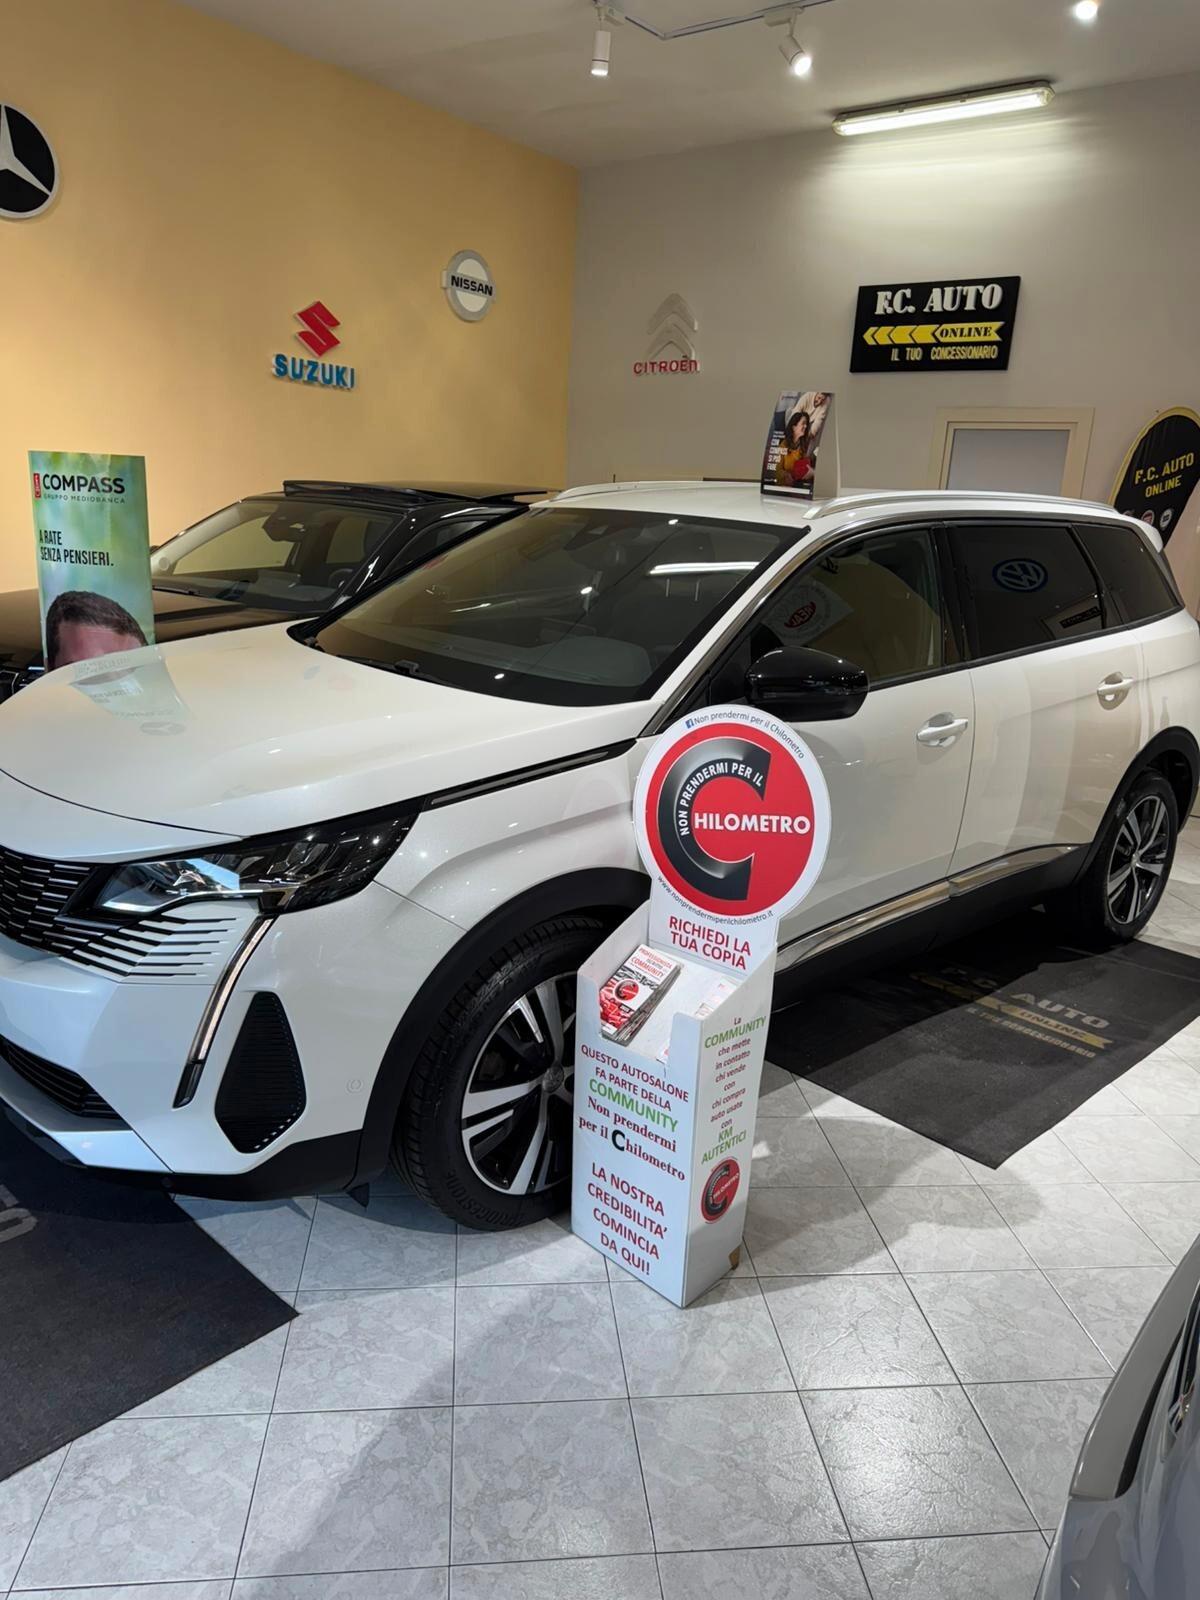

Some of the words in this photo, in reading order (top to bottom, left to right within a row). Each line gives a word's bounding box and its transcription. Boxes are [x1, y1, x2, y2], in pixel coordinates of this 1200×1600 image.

[451, 275, 493, 296] NISSAN
[874, 287, 916, 315] F.C.
[923, 283, 1003, 313] AUTO
[940, 326, 992, 339] ONLINE
[891, 348, 900, 361] IL
[906, 347, 923, 361] TUO
[931, 345, 998, 361] CONCESSIONARIO
[272, 353, 356, 389] SUZUKI
[1134, 467, 1159, 485] F.C.
[1162, 452, 1195, 476] AUTO
[42, 473, 125, 494] COMPASS
[1145, 475, 1182, 498] ONLINE
[43, 493, 69, 501] GRUPPO
[71, 495, 125, 504] MEDIOBANCA
[39, 529, 44, 544] A
[44, 530, 62, 546] RATE
[40, 546, 62, 562] SENZA
[63, 549, 114, 567] PENSIERI.
[694, 714, 709, 725] Non
[711, 711, 749, 721] prendermi
[750, 716, 763, 726] per
[764, 721, 770, 729] il
[769, 723, 805, 759] Chilometro
[731, 762, 753, 779] PER
[752, 772, 764, 788] IL
[680, 762, 728, 808] PRENDERMI
[678, 810, 690, 836] NON
[669, 915, 729, 948] RICHIEDI
[733, 938, 751, 956] LA
[670, 930, 698, 952] TUA
[702, 944, 746, 970] COPIA
[631, 956, 664, 979] COMMUNITY
[733, 1017, 741, 1026] La
[1010, 993, 1110, 1028] AUTO
[704, 1016, 766, 1048] COMMUNITY
[1020, 1011, 1084, 1038] ONLINE
[715, 1061, 722, 1070] in
[723, 1050, 751, 1066] contatto
[718, 1045, 730, 1056] che
[731, 1038, 751, 1051] mette
[581, 1044, 619, 1069] QUESTO
[621, 1063, 688, 1103] AUTOSALONE
[715, 1072, 726, 1083] chi
[727, 1063, 746, 1077] vende
[723, 1081, 736, 1091] con
[595, 1067, 607, 1080] FA
[609, 1073, 638, 1095] PARTE
[641, 1088, 671, 1112] DELLA
[712, 1097, 722, 1109] chi
[722, 1088, 746, 1105] compra
[589, 1078, 678, 1132] COMMUNITY
[711, 1109, 725, 1122] auto
[726, 1101, 743, 1114] usate
[588, 1096, 610, 1118] Non
[613, 1111, 677, 1153] prendermi
[718, 1126, 733, 1142] KM
[721, 1118, 732, 1129] con
[579, 1116, 597, 1132] per
[600, 1124, 608, 1139] il
[611, 1129, 685, 1181] Chilometro
[701, 1130, 747, 1165] AUTENTICI
[592, 1162, 607, 1182] LA
[610, 1173, 664, 1216] NOSTRA
[587, 1182, 667, 1240] CREDIBILITA'
[593, 1207, 660, 1260] COMINCIA
[600, 1232, 618, 1254] DA
[621, 1247, 650, 1275] QUI!
